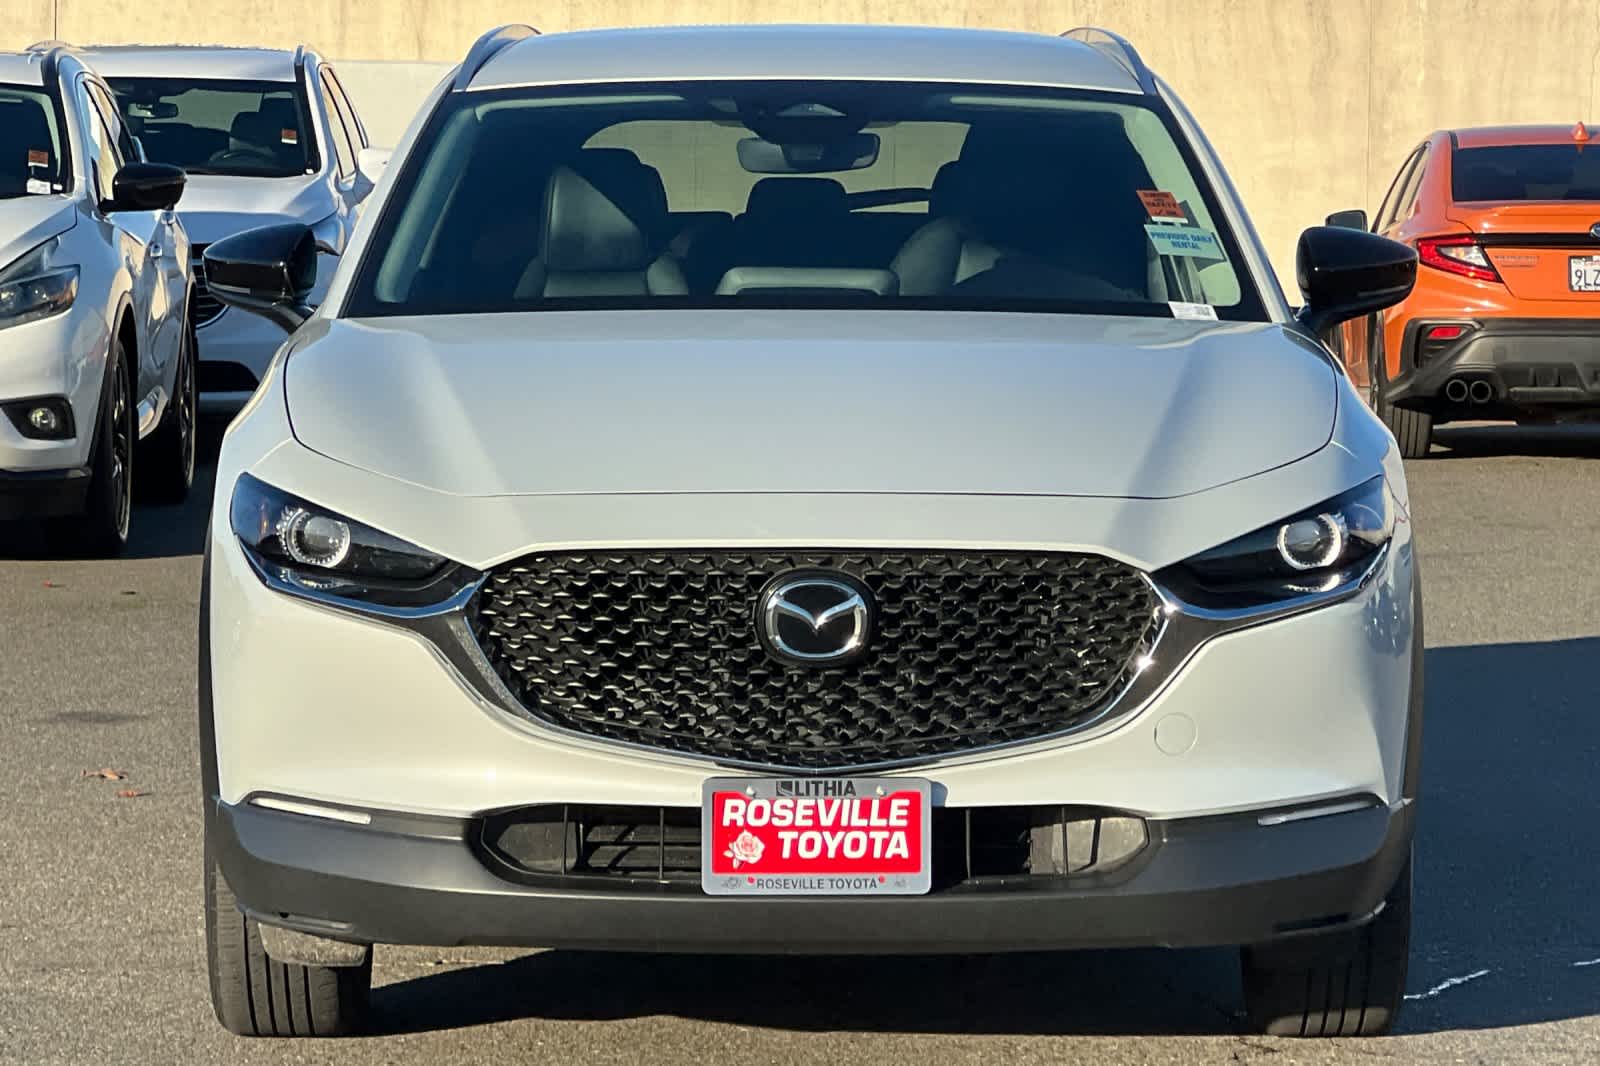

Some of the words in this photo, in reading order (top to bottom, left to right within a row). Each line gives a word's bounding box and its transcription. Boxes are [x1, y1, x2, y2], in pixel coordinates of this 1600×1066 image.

[1150, 231, 1190, 241] PREVIOUS
[1191, 233, 1213, 243] DAILY
[1171, 241, 1201, 250] RENTAL
[794, 781, 856, 797] LITHIA
[722, 798, 910, 827] ROSEVILLE
[777, 831, 909, 859] TOYOTA
[756, 878, 824, 889] ROSEVILLE
[828, 878, 878, 888] TOYOTA
